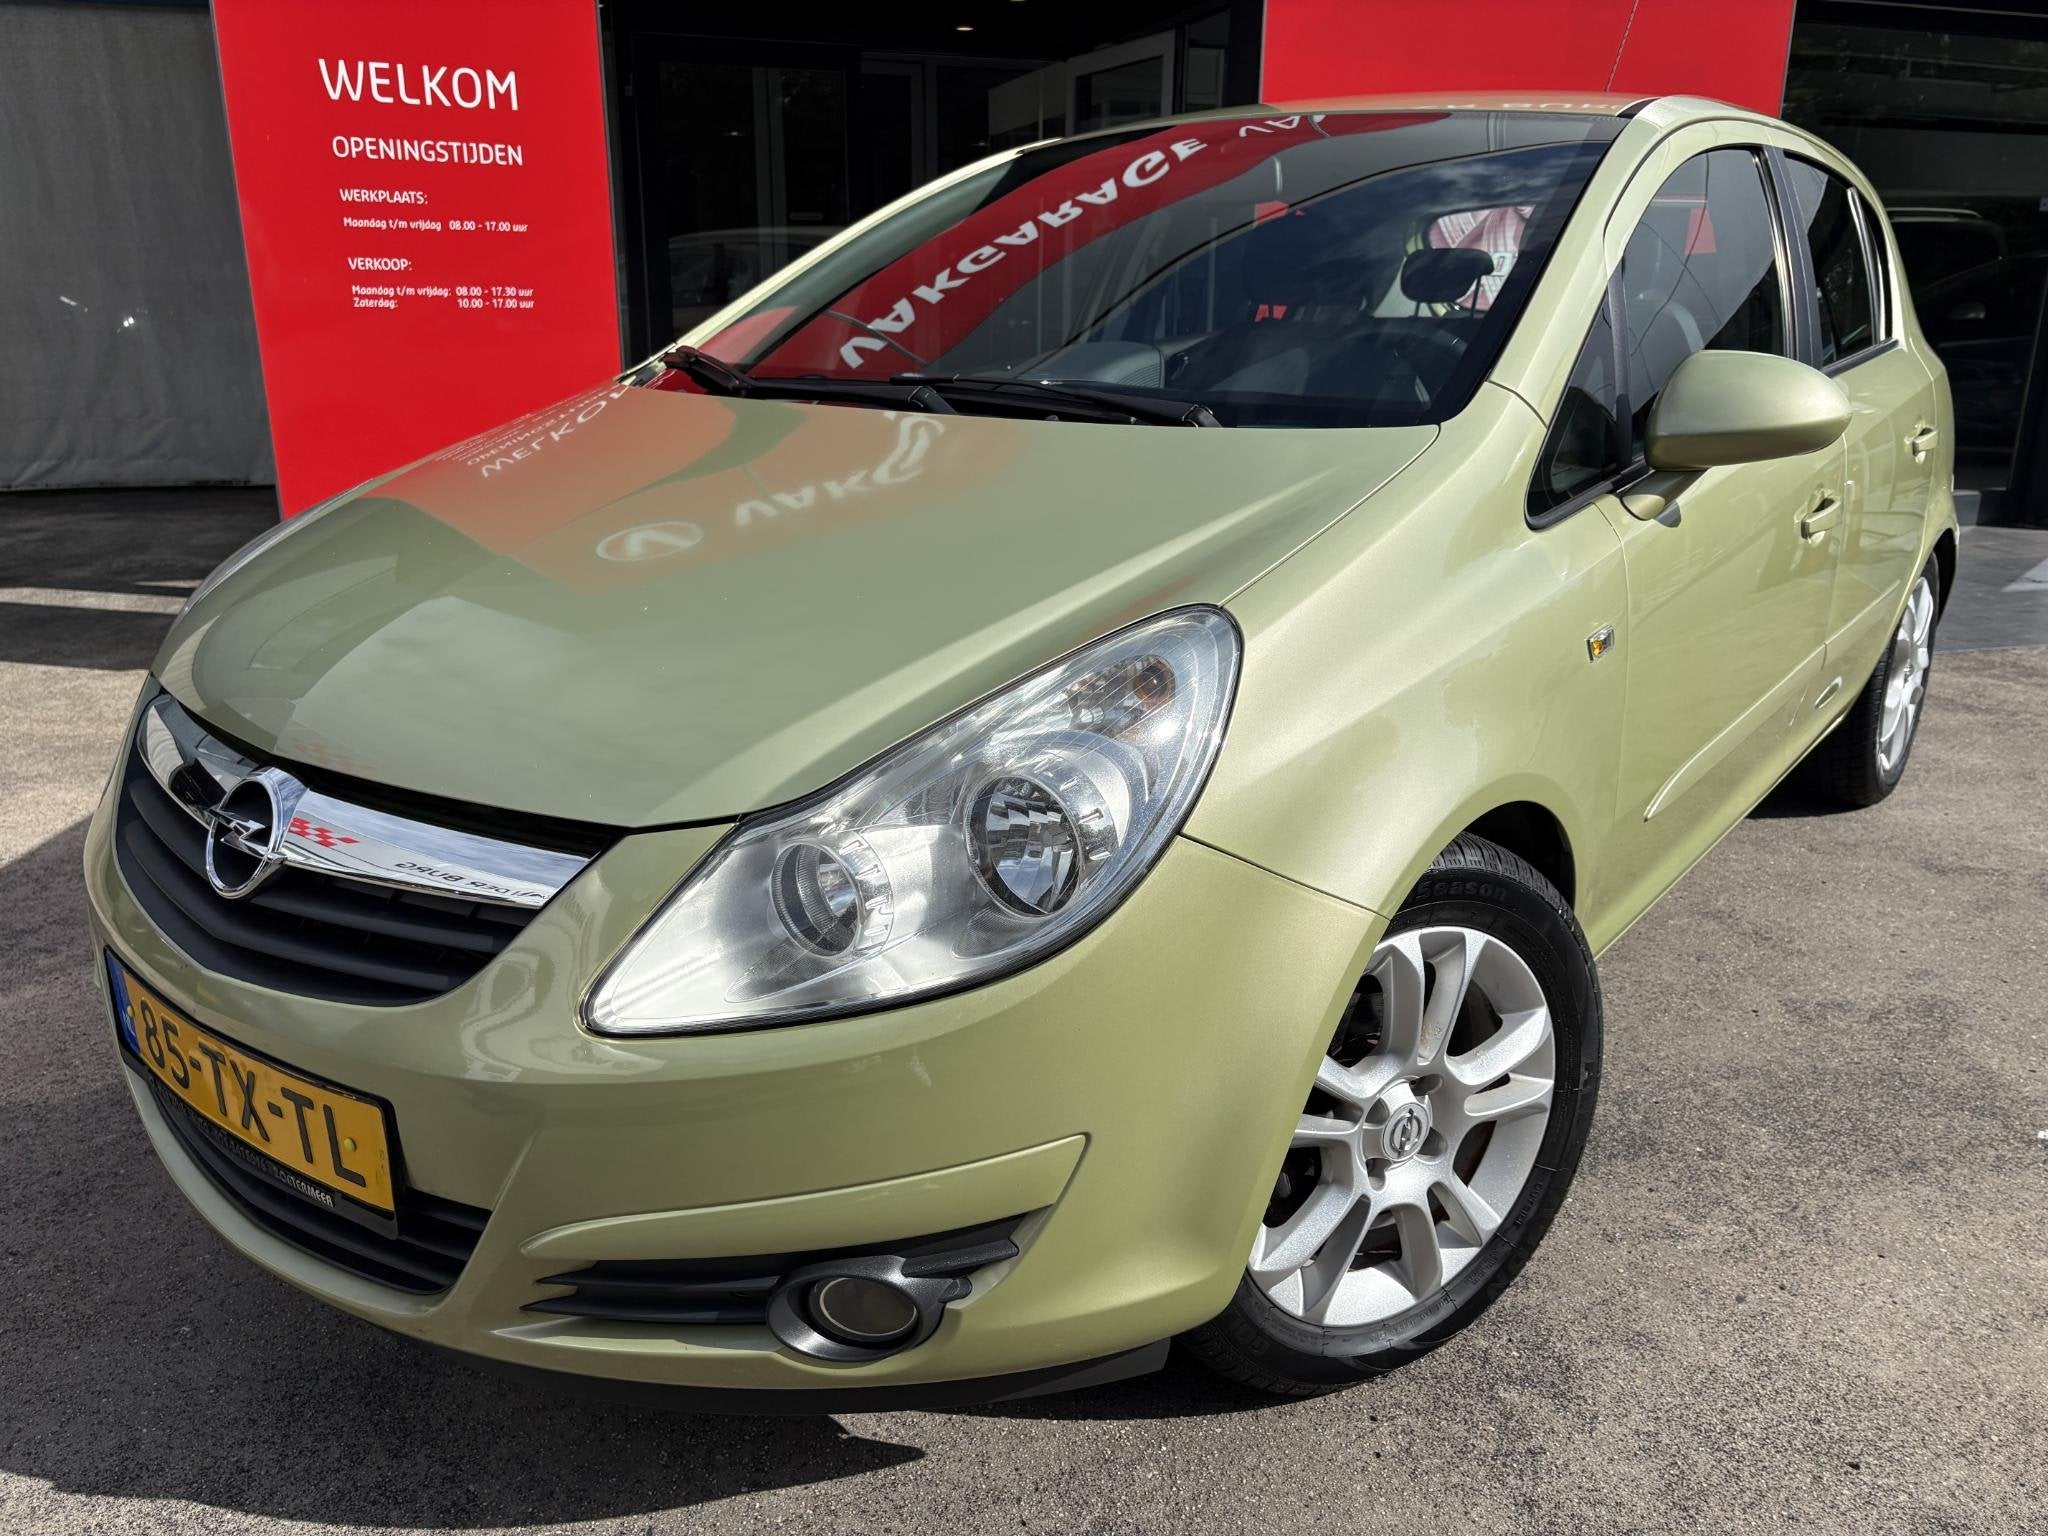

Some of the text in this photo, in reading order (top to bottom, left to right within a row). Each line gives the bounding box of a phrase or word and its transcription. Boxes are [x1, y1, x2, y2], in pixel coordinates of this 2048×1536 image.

[318, 58, 519, 111] WELKOM
[332, 135, 523, 166] OPENINGSTIJDEN
[339, 188, 429, 205] WERKPLAATS:
[343, 217, 387, 231] Maandag
[388, 218, 408, 230] t/m
[409, 219, 442, 232] vrijdag
[449, 220, 476, 231] 08.00
[485, 220, 511, 232] 17.00
[512, 223, 529, 232] uur
[348, 257, 413, 271] VERKOOP:
[352, 285, 394, 297] Maandag
[396, 285, 415, 296] t/m
[417, 286, 452, 298] vrijdag:
[455, 286, 482, 296] 08.00
[491, 286, 517, 297] 17.30
[518, 288, 534, 297] uur
[353, 297, 399, 309] Zaterdag:
[457, 298, 483, 309] 10.00
[492, 298, 518, 309] 17.00
[519, 300, 535, 309] uur
[140, 999, 366, 1188] 85-TX-TL
